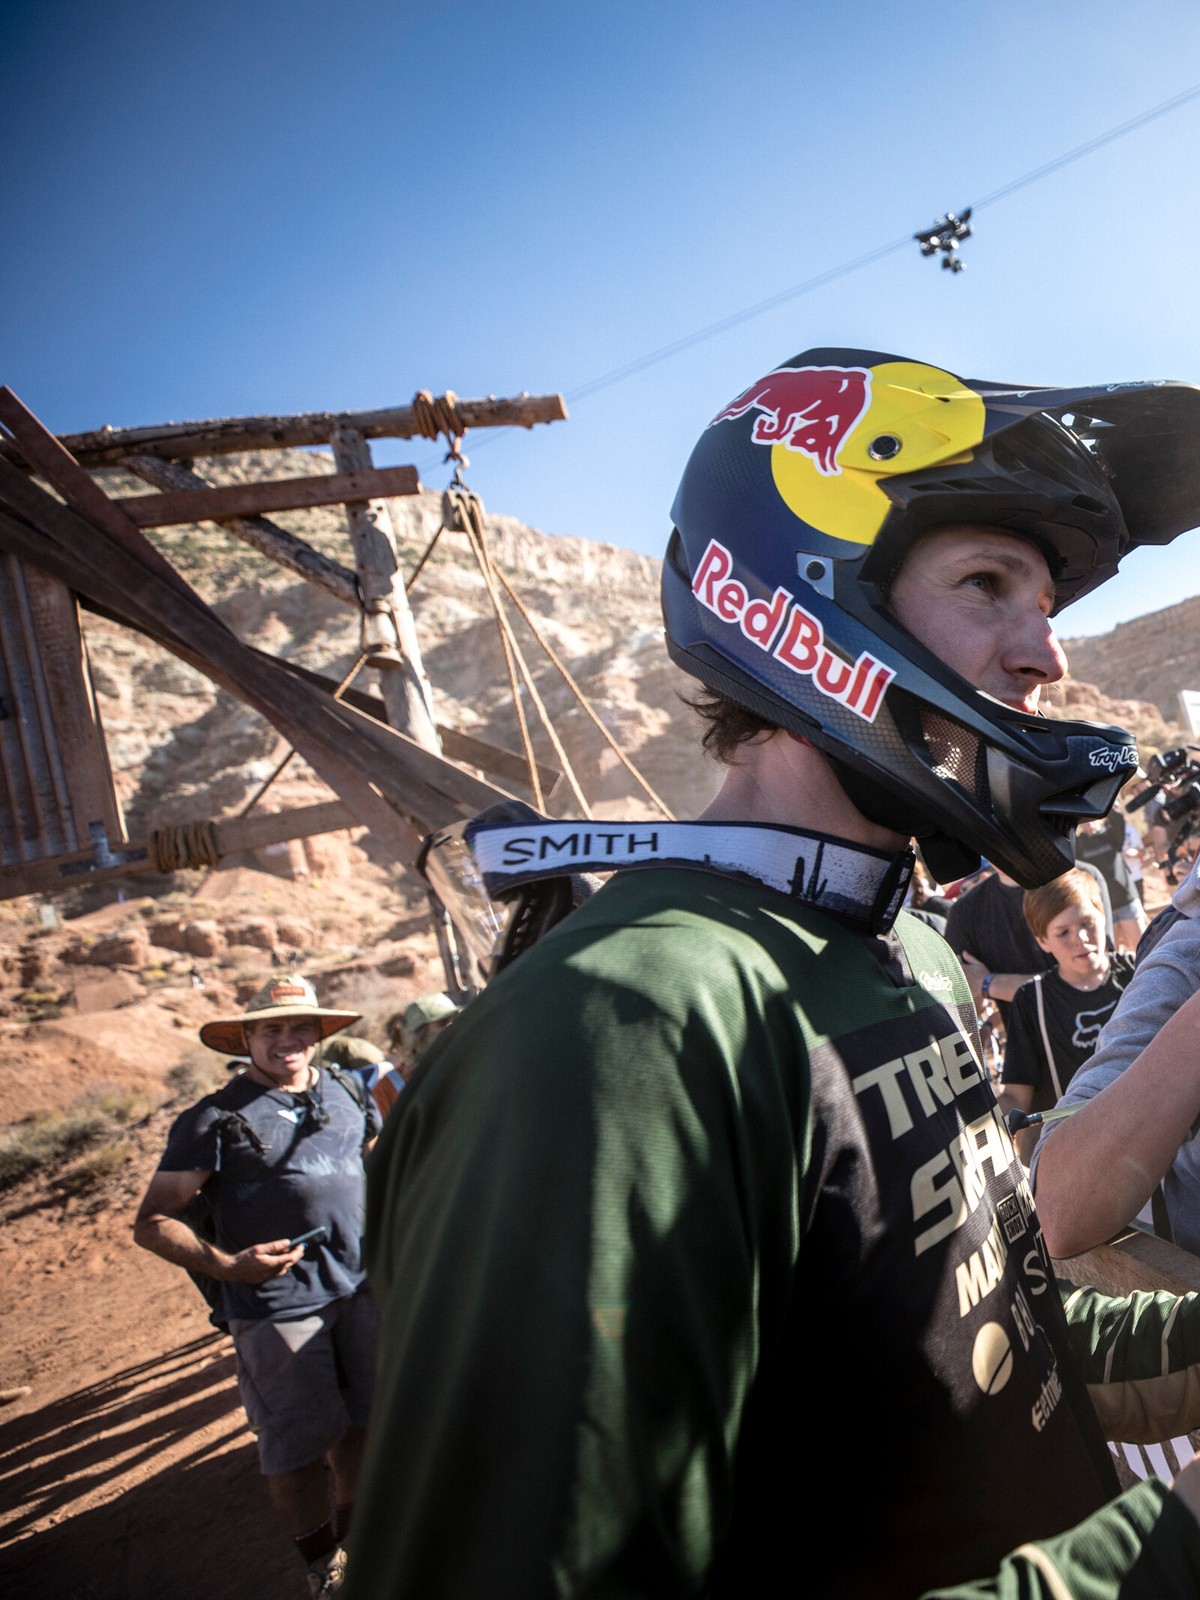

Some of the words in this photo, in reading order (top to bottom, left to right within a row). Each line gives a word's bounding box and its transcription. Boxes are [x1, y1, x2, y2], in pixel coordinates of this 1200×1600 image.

[693, 541, 790, 648] Red
[775, 607, 893, 719] Bull
[1089, 747, 1119, 773] Troy
[502, 832, 659, 866] SMITH
[852, 1031, 986, 1141] TRE
